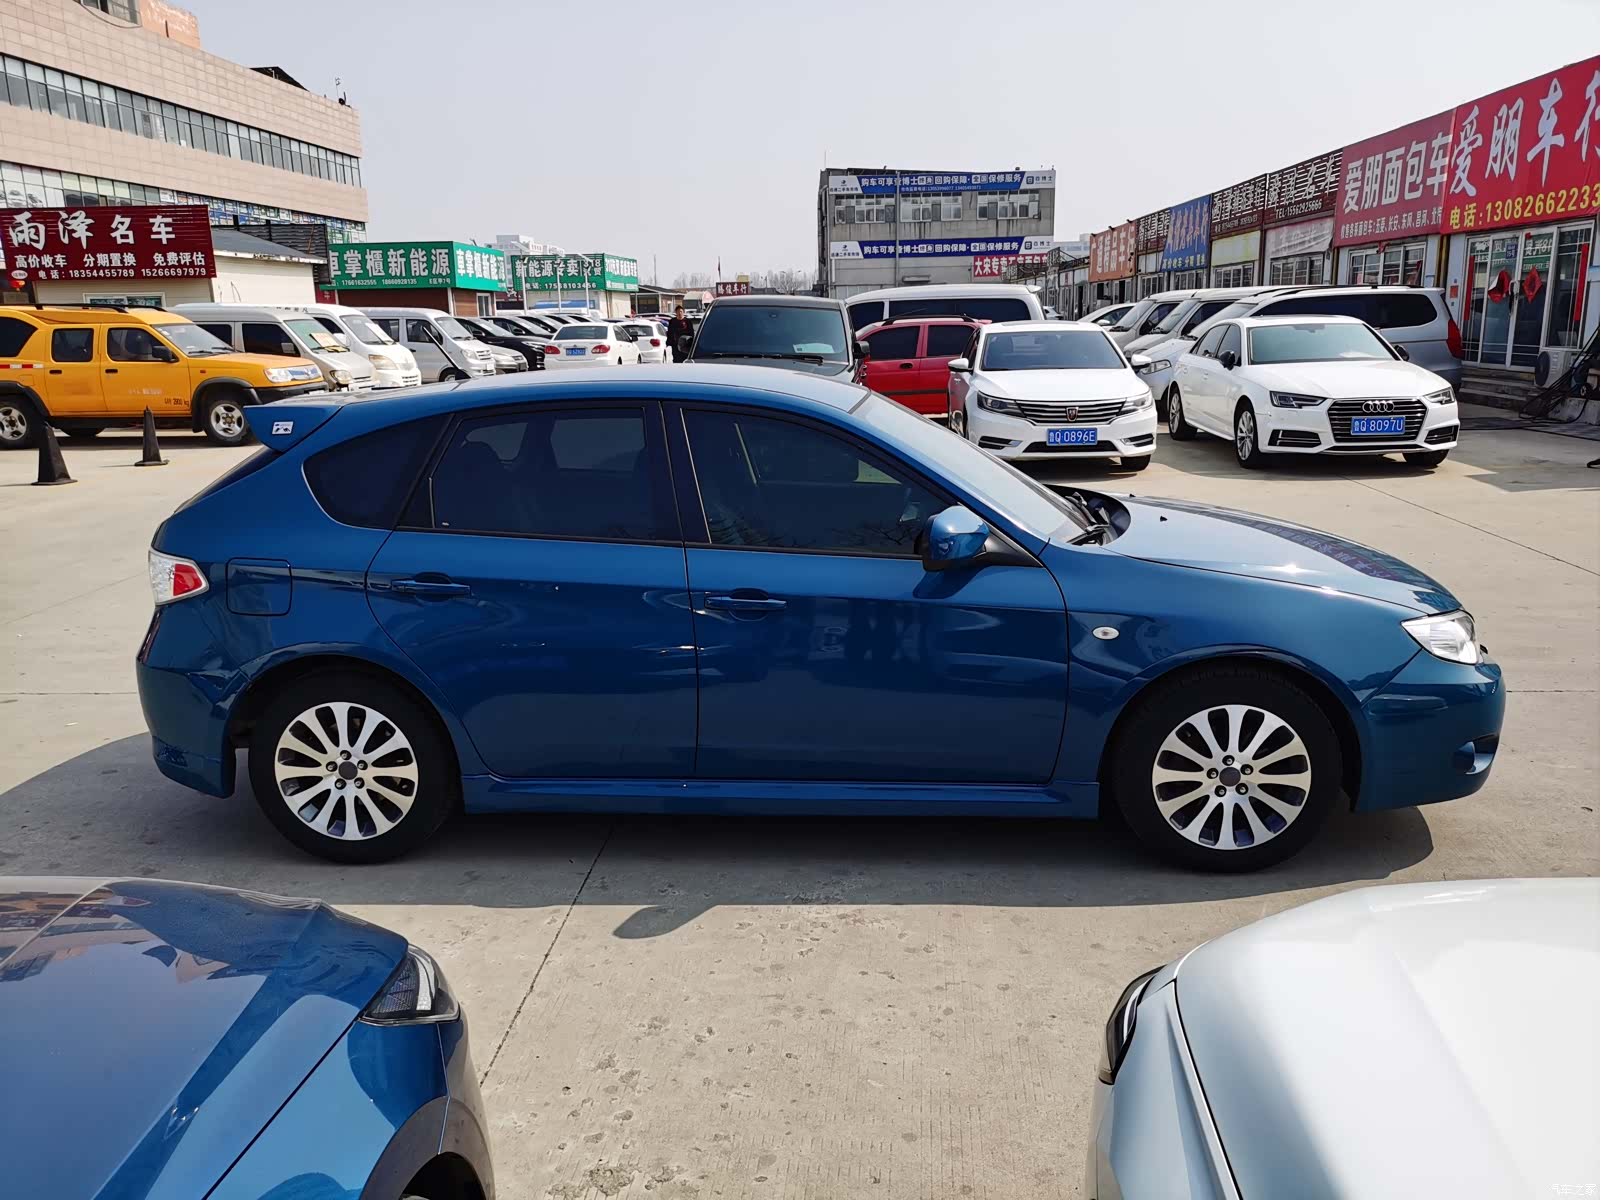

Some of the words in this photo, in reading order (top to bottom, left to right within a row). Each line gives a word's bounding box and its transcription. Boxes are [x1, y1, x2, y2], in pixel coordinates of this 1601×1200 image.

[1342, 131, 1453, 214] 爱朋面包车
[9, 210, 177, 250] 雨泽名车
[14, 253, 68, 268] 高价收车
[83, 252, 137, 267] 分期置换
[153, 251, 206, 266] 免费评估
